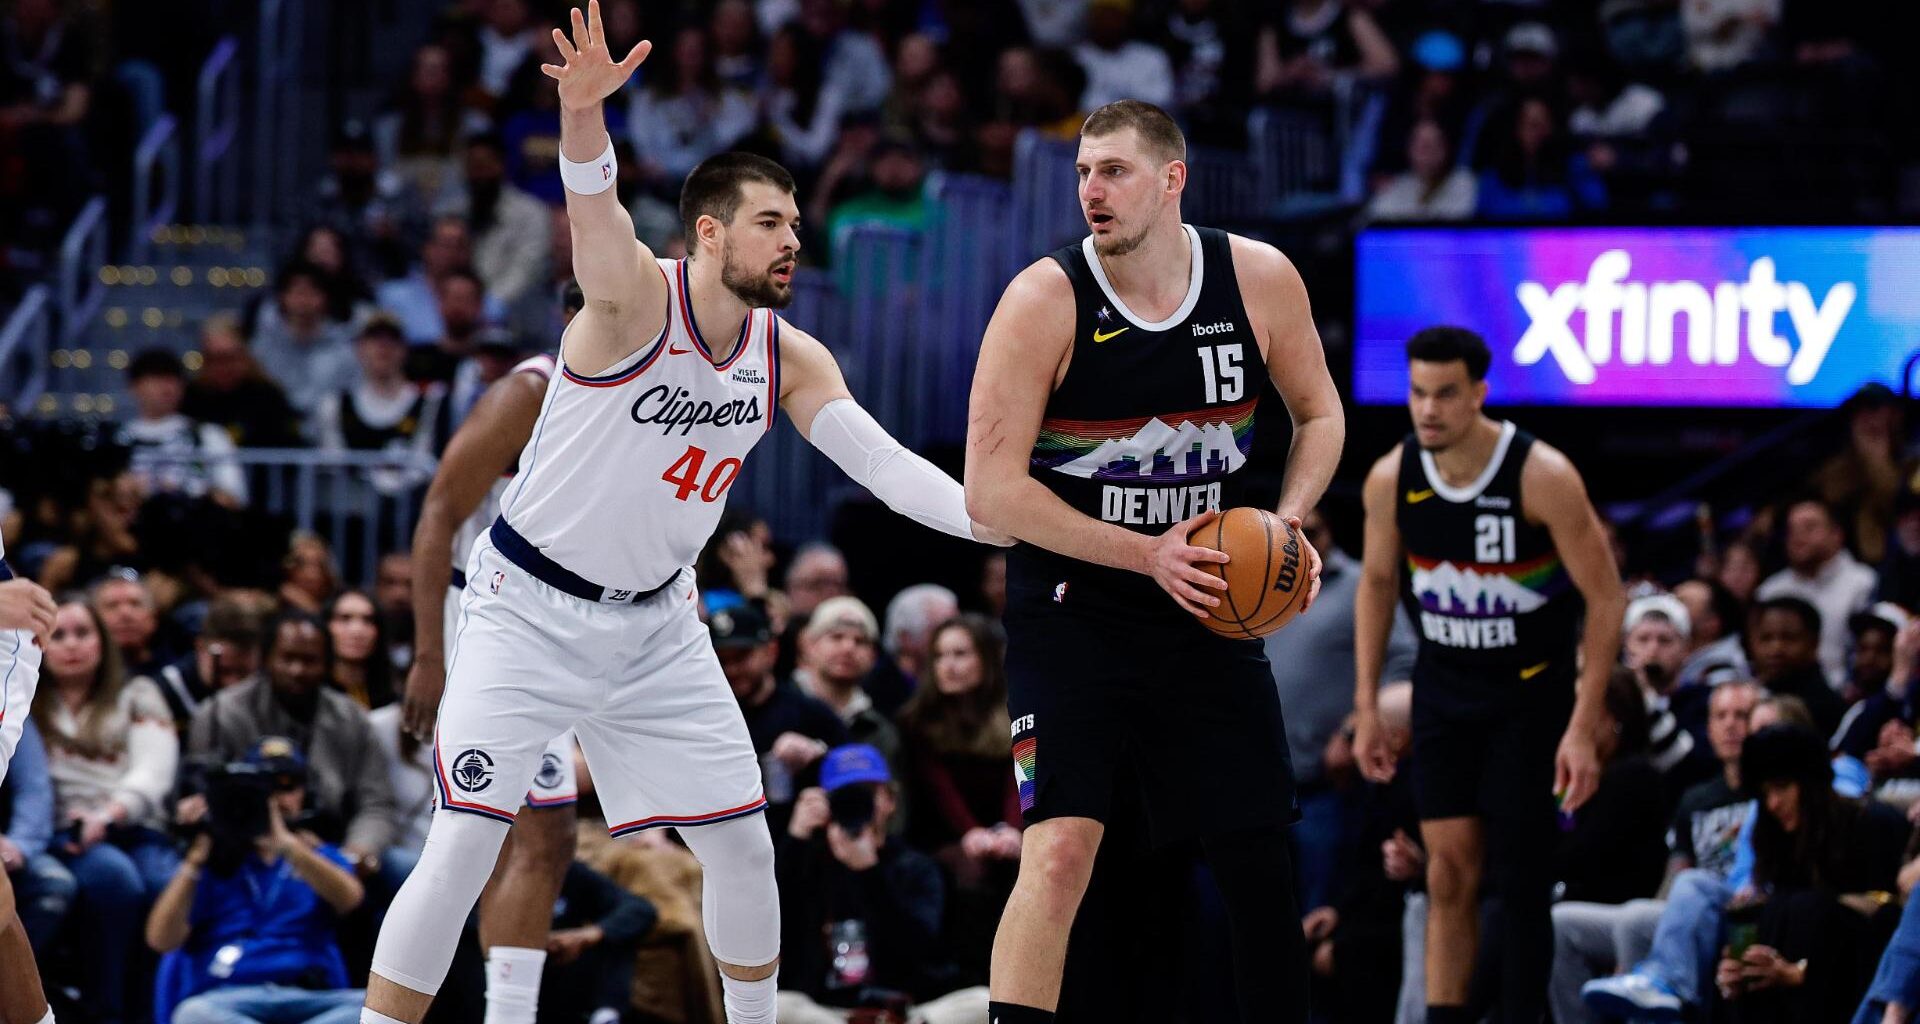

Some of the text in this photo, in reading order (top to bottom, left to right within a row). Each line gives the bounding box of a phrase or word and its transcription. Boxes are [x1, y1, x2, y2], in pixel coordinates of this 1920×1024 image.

[1192, 322, 1234, 336] ibotta
[1512, 249, 1857, 385] xfinity
[732, 374, 766, 384] RWANDA
[738, 368, 757, 376] VISIT
[1198, 343, 1243, 404] 15
[631, 385, 763, 436] Clippers
[661, 445, 742, 502] 40
[1101, 482, 1221, 525] DENVER
[1475, 514, 1516, 563] 21
[1421, 610, 1517, 649] DENVER
